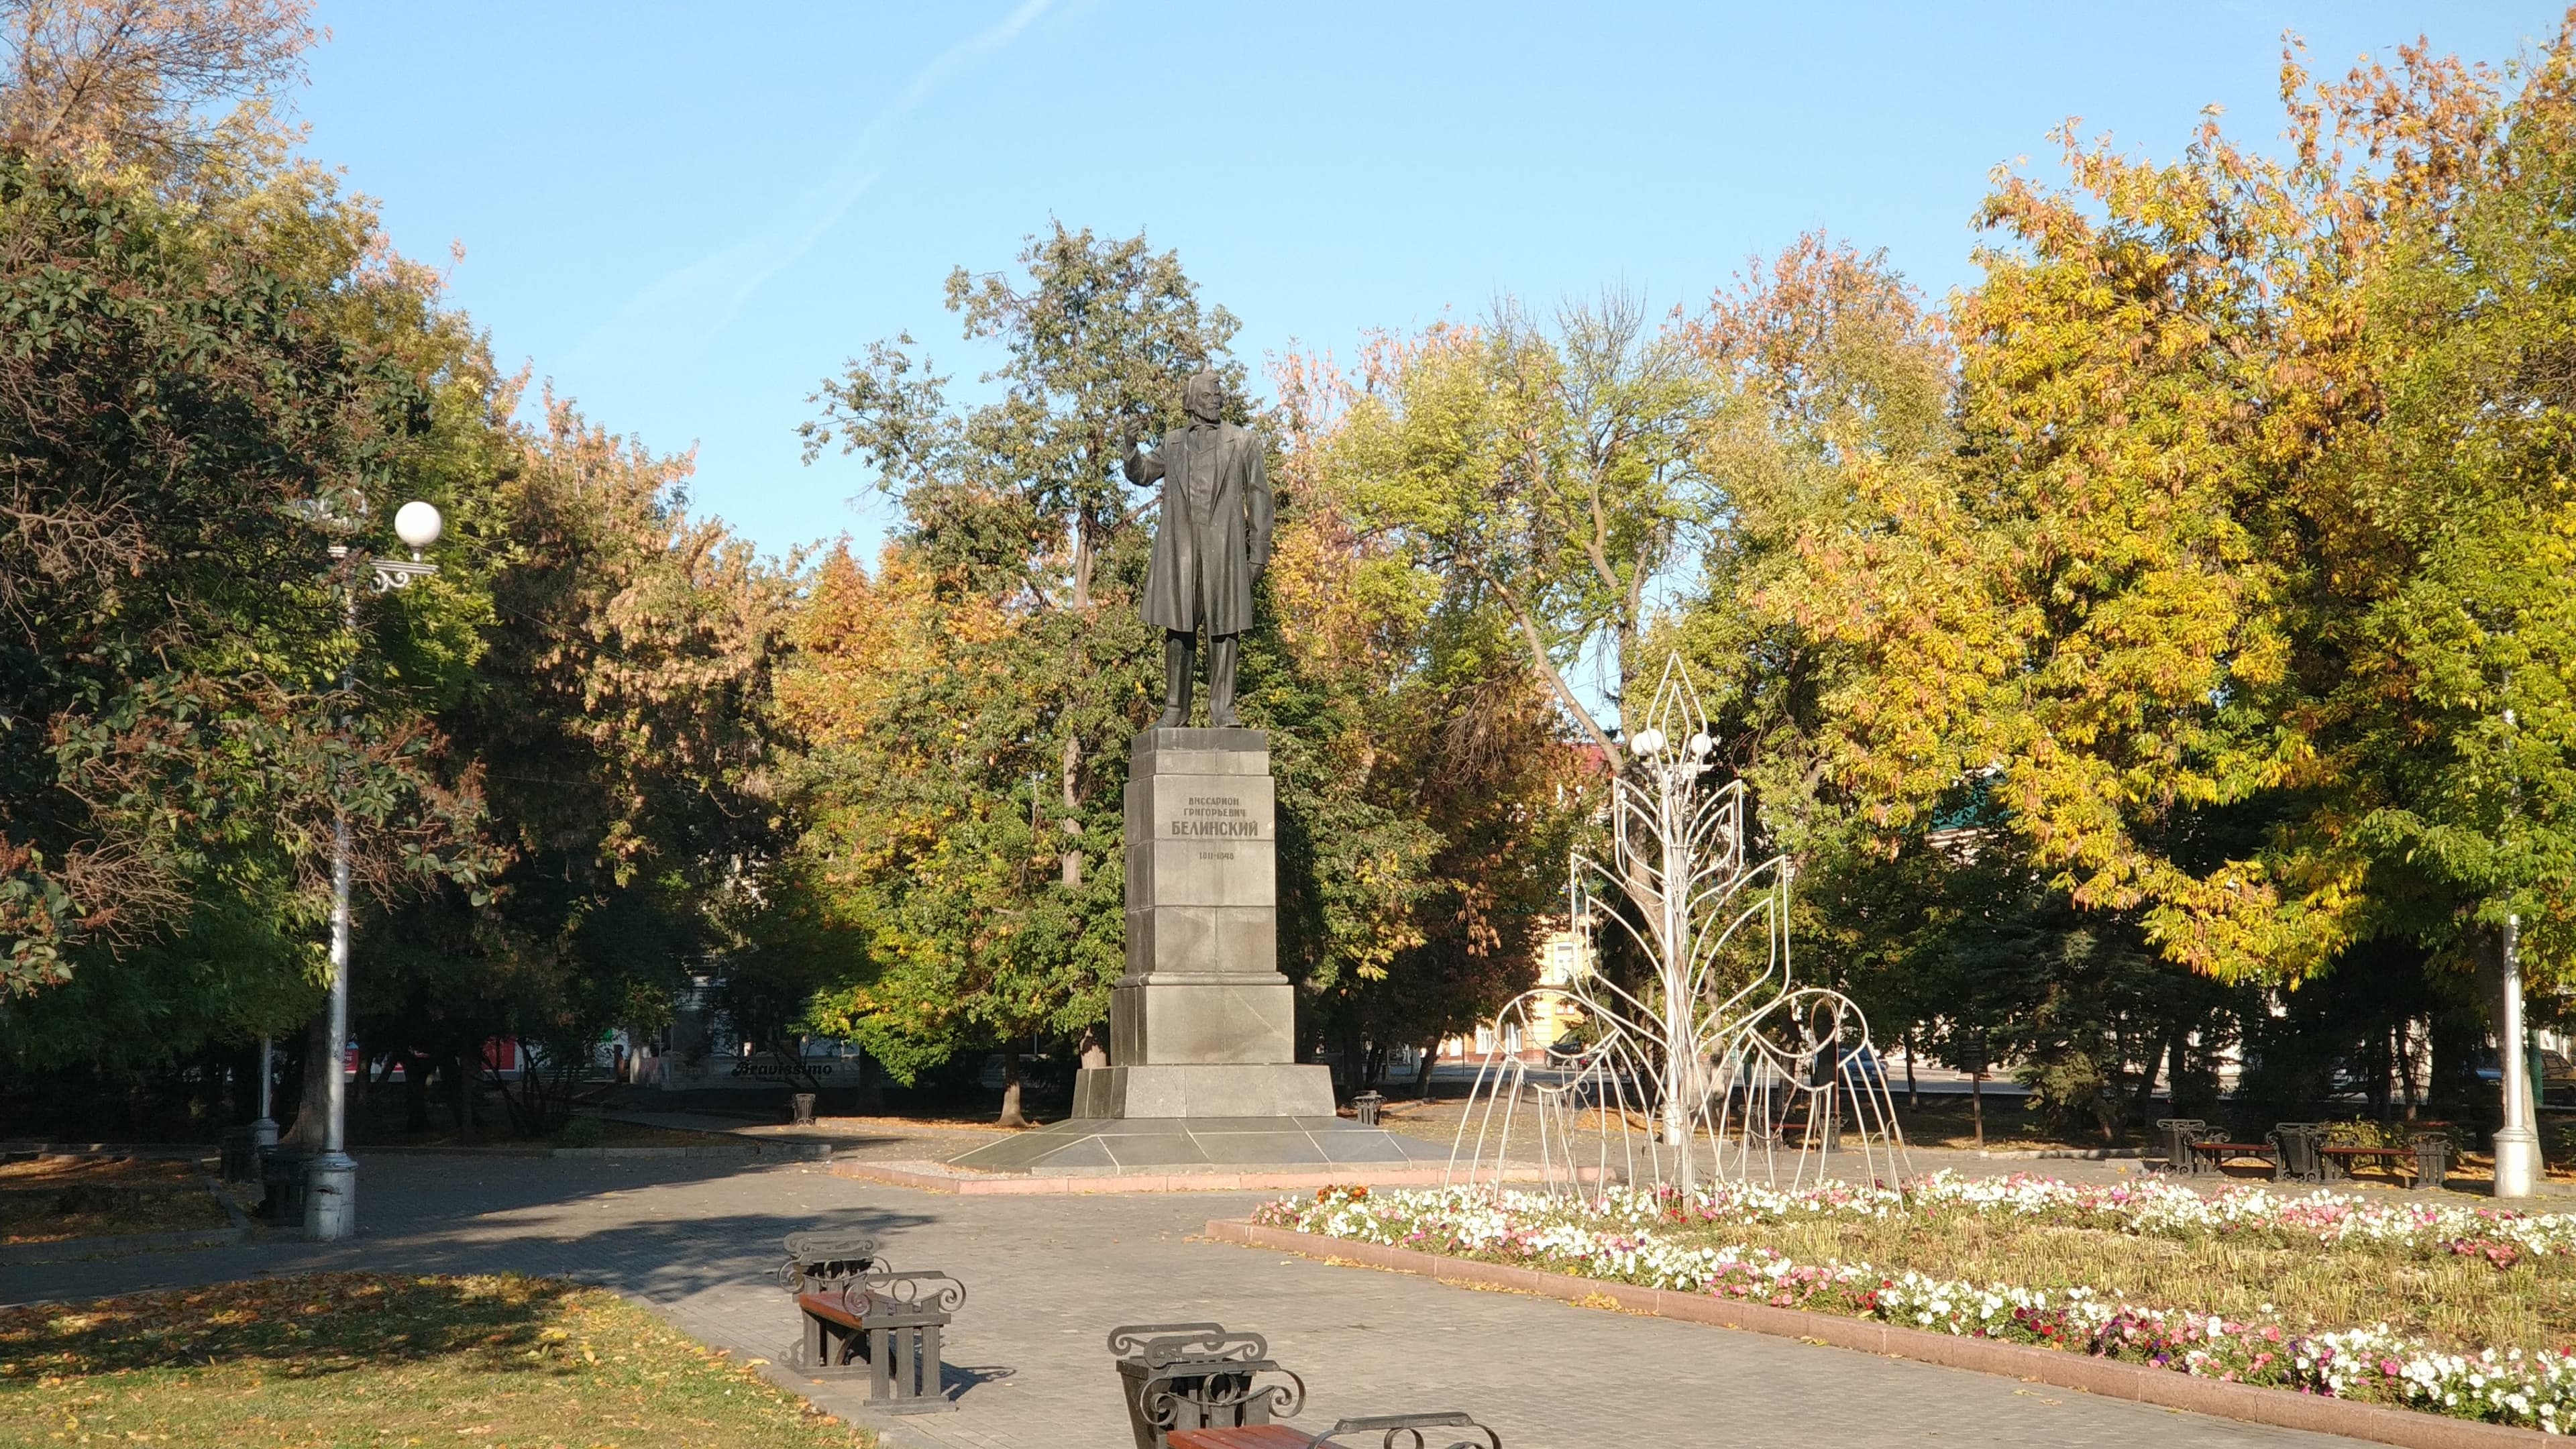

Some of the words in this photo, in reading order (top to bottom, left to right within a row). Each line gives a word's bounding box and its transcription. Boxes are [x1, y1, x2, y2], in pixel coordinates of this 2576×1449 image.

[1189, 797, 1239, 805] ВИССАРИОН
[1183, 808, 1246, 816] ГРИГОРЬЕВИЧ
[1171, 820, 1258, 836] БЕЛИНСКИЙ
